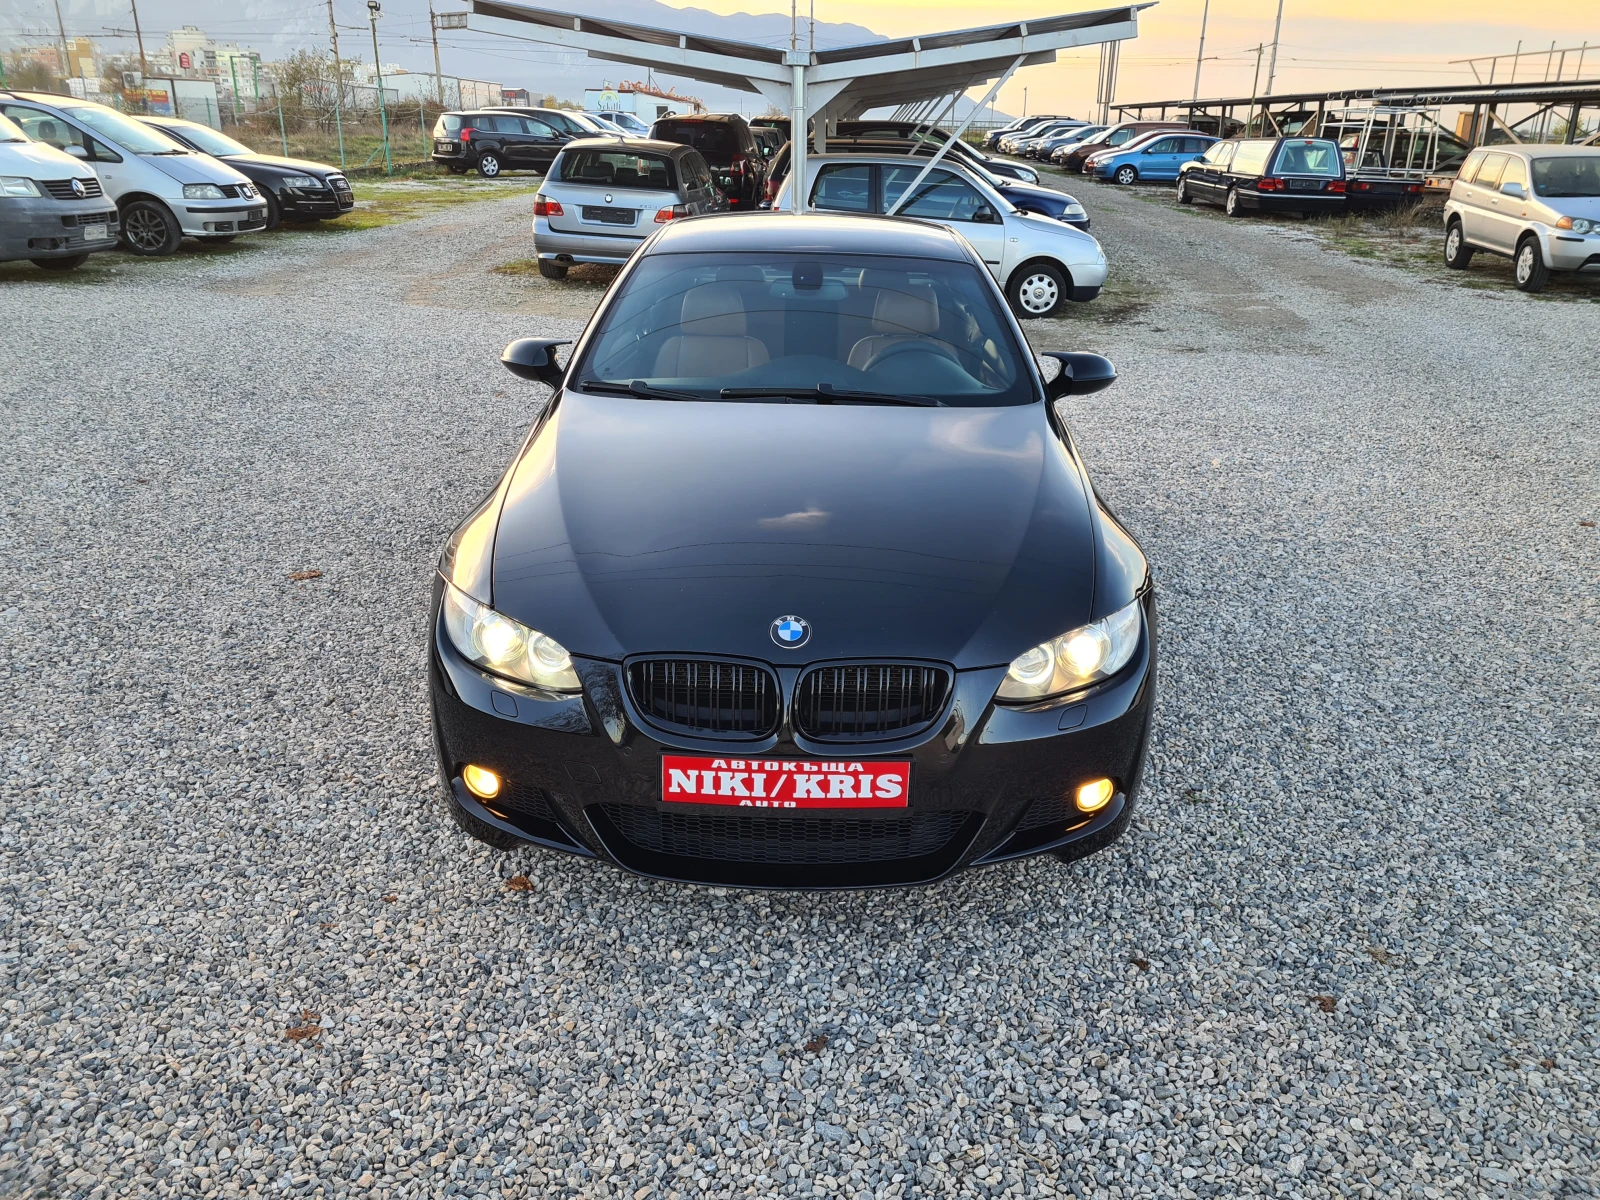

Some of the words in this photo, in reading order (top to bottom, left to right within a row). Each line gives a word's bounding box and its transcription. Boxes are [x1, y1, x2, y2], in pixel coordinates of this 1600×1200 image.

[774, 615, 808, 627] BMW
[710, 759, 865, 772] АВТОКЪЩА
[668, 768, 903, 799] NIKI/KRIS
[738, 799, 797, 808] AUTO
